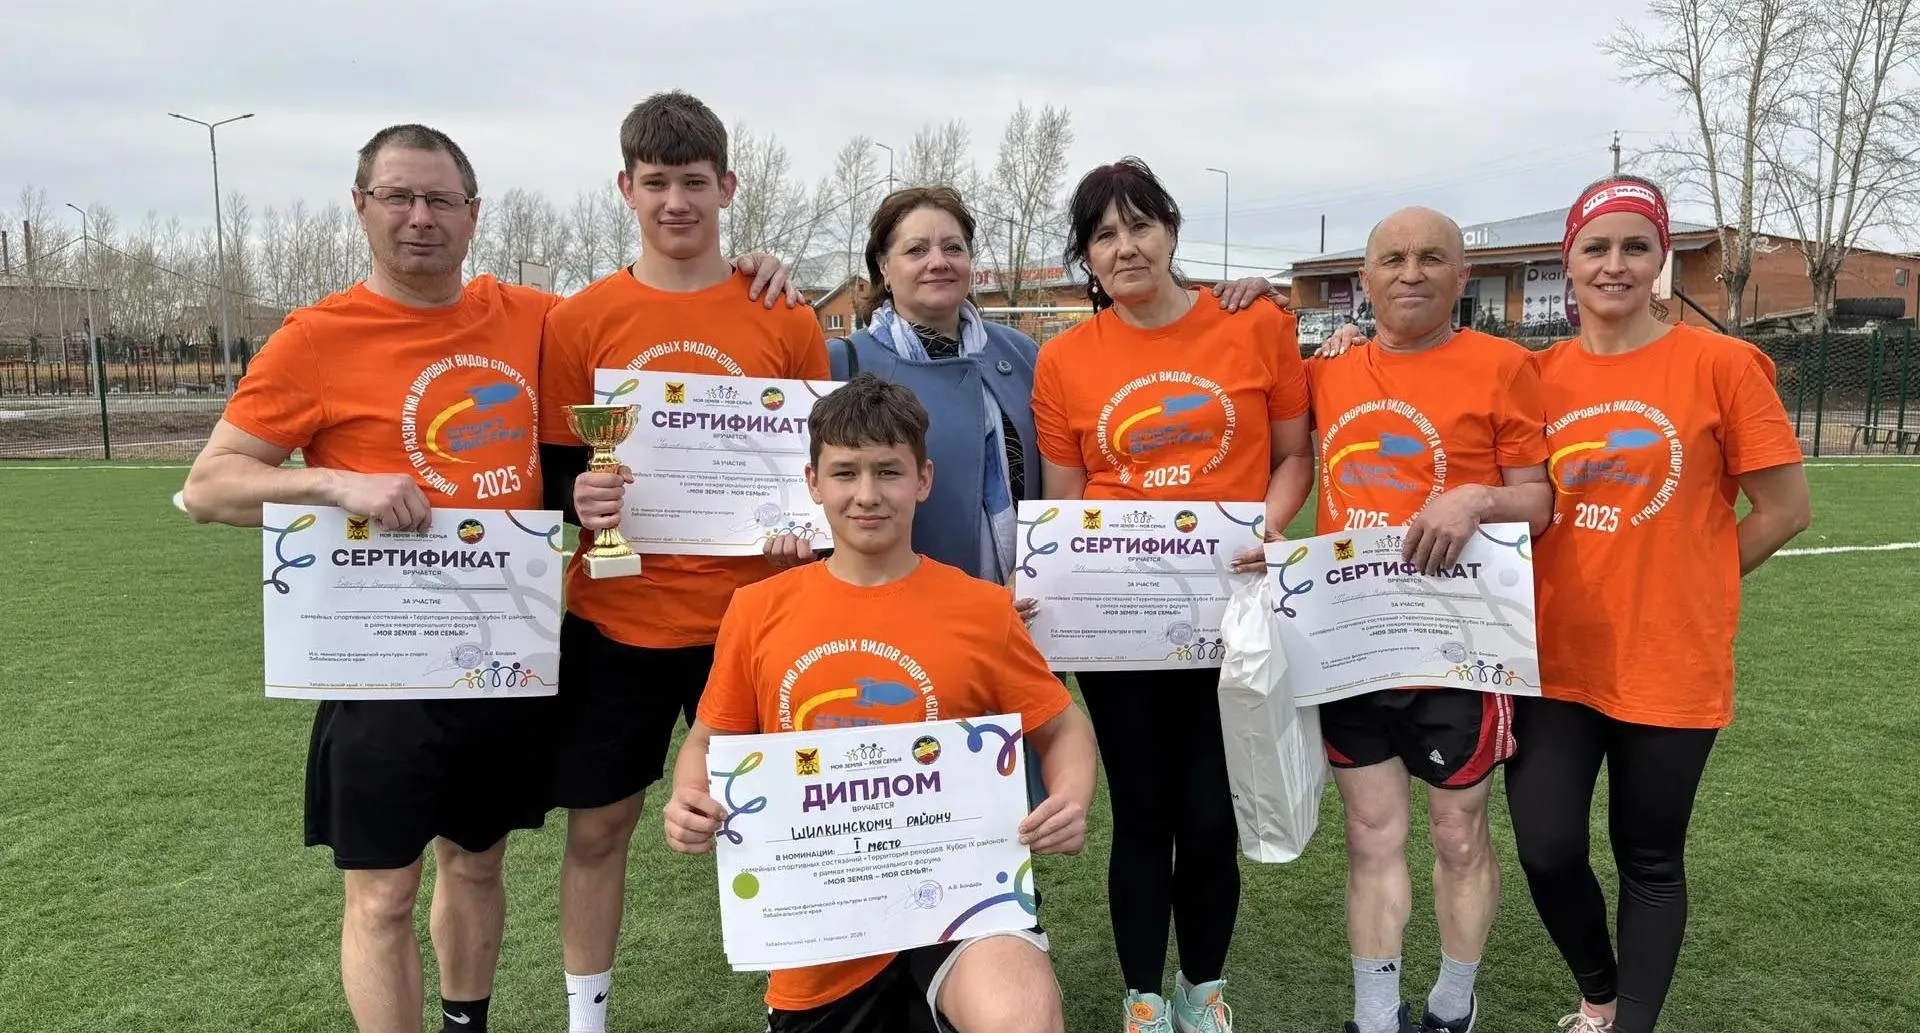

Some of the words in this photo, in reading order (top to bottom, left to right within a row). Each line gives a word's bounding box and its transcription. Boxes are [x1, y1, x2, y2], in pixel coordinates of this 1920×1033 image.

[1462, 227, 1489, 245] ari
[454, 354, 489, 368] ВИДОВ
[626, 340, 682, 373] ДВОРОВЫХ
[683, 340, 719, 360] ВИДОВ
[411, 356, 455, 397] ДВОРОВЫХ
[491, 359, 526, 388] СПОРТА
[1159, 371, 1192, 383] ВИДОВ
[1192, 376, 1223, 396] СПОРТА
[1110, 373, 1158, 406] ДВОРОВЫХ
[1219, 394, 1236, 430] «СПОРТ
[1553, 402, 1611, 432] ДВОРОВЫХ
[1613, 399, 1647, 413] ВИДОВ
[401, 394, 420, 452] РАЗВИТИЮ
[651, 411, 807, 434] СЕРТИФИКАТ
[1096, 406, 1114, 455] РАЗВИТИЮ
[1338, 399, 1387, 429] ДВОРОВЫХ
[1387, 399, 1417, 418] ВИДОВ
[1413, 413, 1440, 449] СПОРТА
[1644, 407, 1678, 438] СПОРТА
[408, 451, 427, 467] ПО
[1202, 430, 1234, 475] БЫСТРЫХ»
[1670, 438, 1684, 478] «СПОРТ
[418, 466, 459, 496] ПРОЕКТ
[472, 465, 522, 500] 2025
[1143, 464, 1191, 489] 2025
[1630, 477, 1679, 527] БЫСТРЫХ»
[1344, 507, 1390, 531] 2025
[1574, 502, 1622, 532] 2025
[331, 549, 511, 569] СЕРТИФИКАТ
[1070, 537, 1220, 555] СЕРТИФИКАТ
[778, 668, 799, 730] РАЗВИТИЮ
[794, 639, 858, 673] ДВОРОВЫХ
[861, 639, 900, 662] ВИДОВ
[899, 654, 935, 695] СПОРТА
[802, 771, 942, 813] ДИПЛОМ
[852, 801, 895, 813] ВРУЧАЕТСЯ
[791, 818, 893, 841] ШИЛКИНСКОМУ
[906, 812, 951, 828] РАЙОНУ
[741, 865, 776, 873] семейных
[778, 862, 819, 871] спортивных
[821, 855, 862, 867] состязаний
[863, 850, 909, 862] «Территория
[946, 841, 967, 851] Кубок
[968, 840, 975, 848] IX
[782, 849, 836, 861] НОМИНАЦИИ:
[868, 839, 902, 852] место
[819, 869, 845, 878] рамках
[845, 861, 913, 874] межрегионального
[914, 856, 942, 866] форума
[823, 878, 846, 886] «МОЯ
[847, 874, 873, 883] ЗЕМЛЯ
[881, 871, 899, 879] МОЯ
